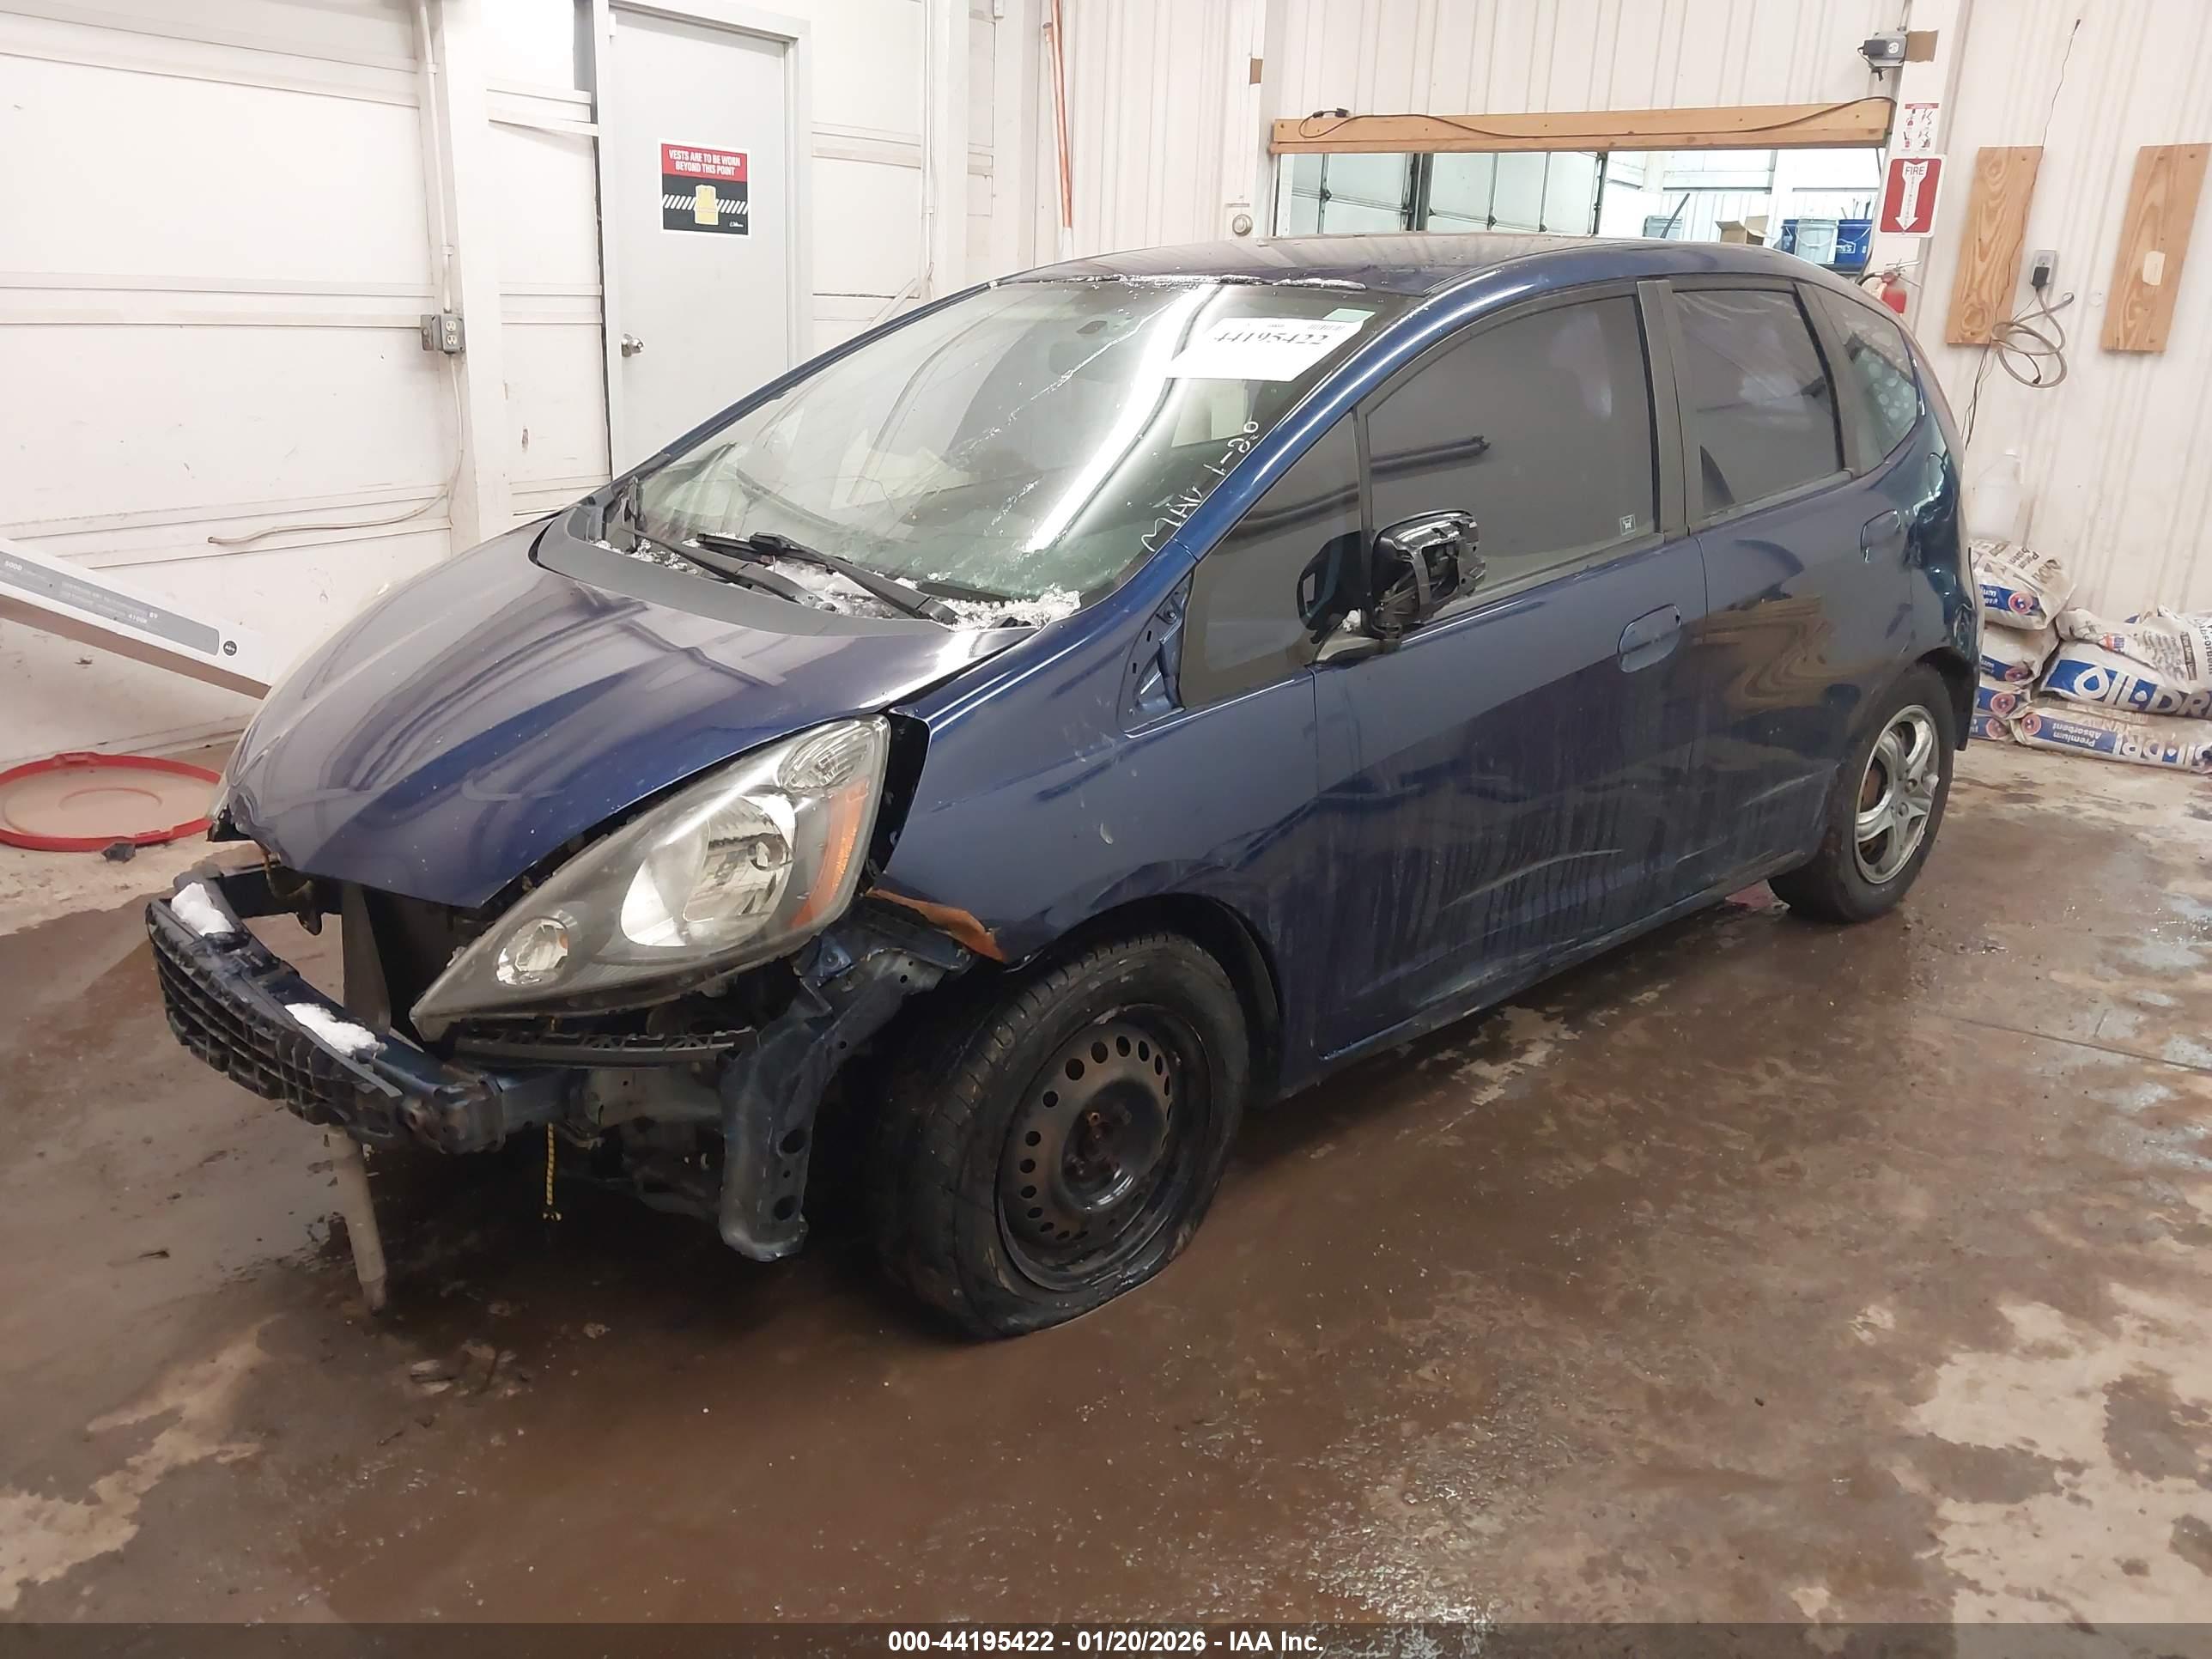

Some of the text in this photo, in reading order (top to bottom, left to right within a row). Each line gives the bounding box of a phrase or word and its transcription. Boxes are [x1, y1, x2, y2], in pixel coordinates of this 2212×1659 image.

[669, 149, 741, 167] VESTS ARE TO BE WORN
[675, 161, 736, 176] BEYOND THIS POINT
[1905, 166, 1925, 176] FIRE
[1214, 332, 1328, 345] 44195422
[2051, 722, 2103, 740] Absorbent
[2052, 731, 2096, 748] Premium
